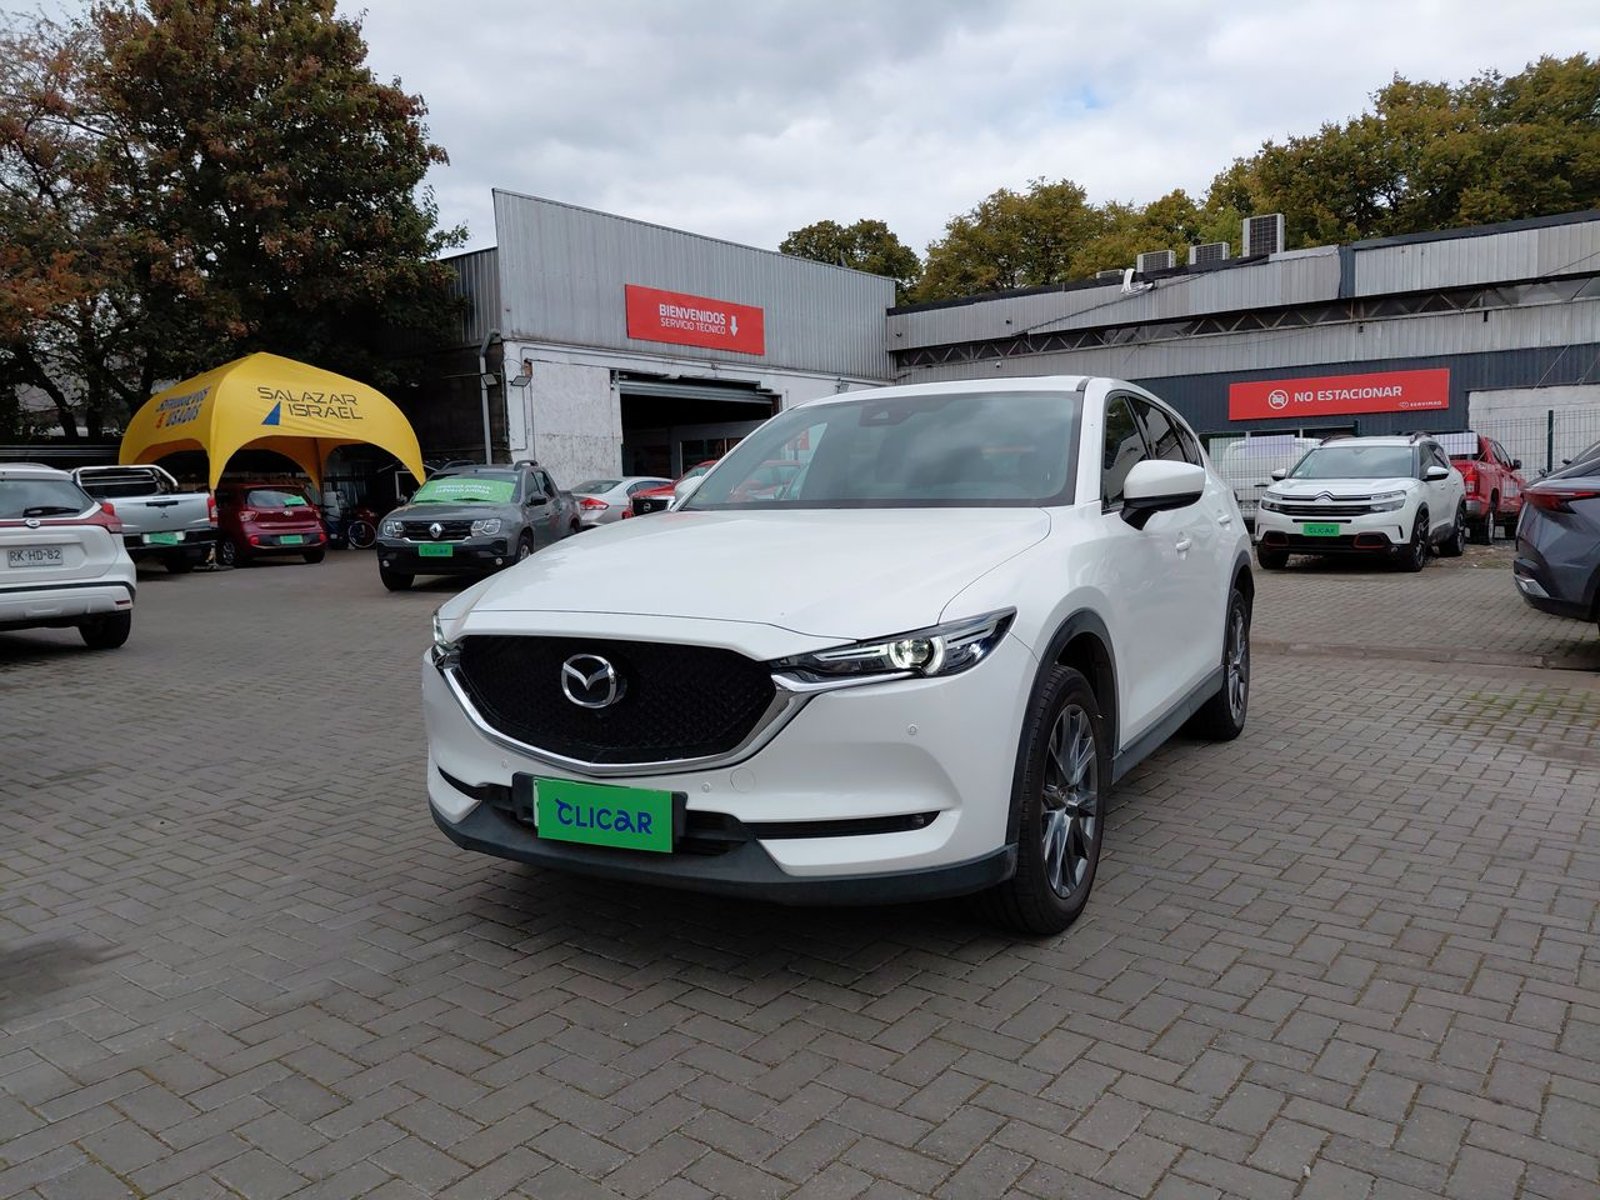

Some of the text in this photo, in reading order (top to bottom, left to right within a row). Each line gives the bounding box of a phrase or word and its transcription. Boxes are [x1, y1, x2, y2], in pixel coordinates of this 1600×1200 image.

[659, 303, 726, 325] BIENVENIDOS
[660, 317, 695, 331] SERVICIO
[257, 386, 358, 406] SALAZAR
[1294, 385, 1402, 402] NO ESTACIONAR
[288, 403, 364, 420] ISRAEL
